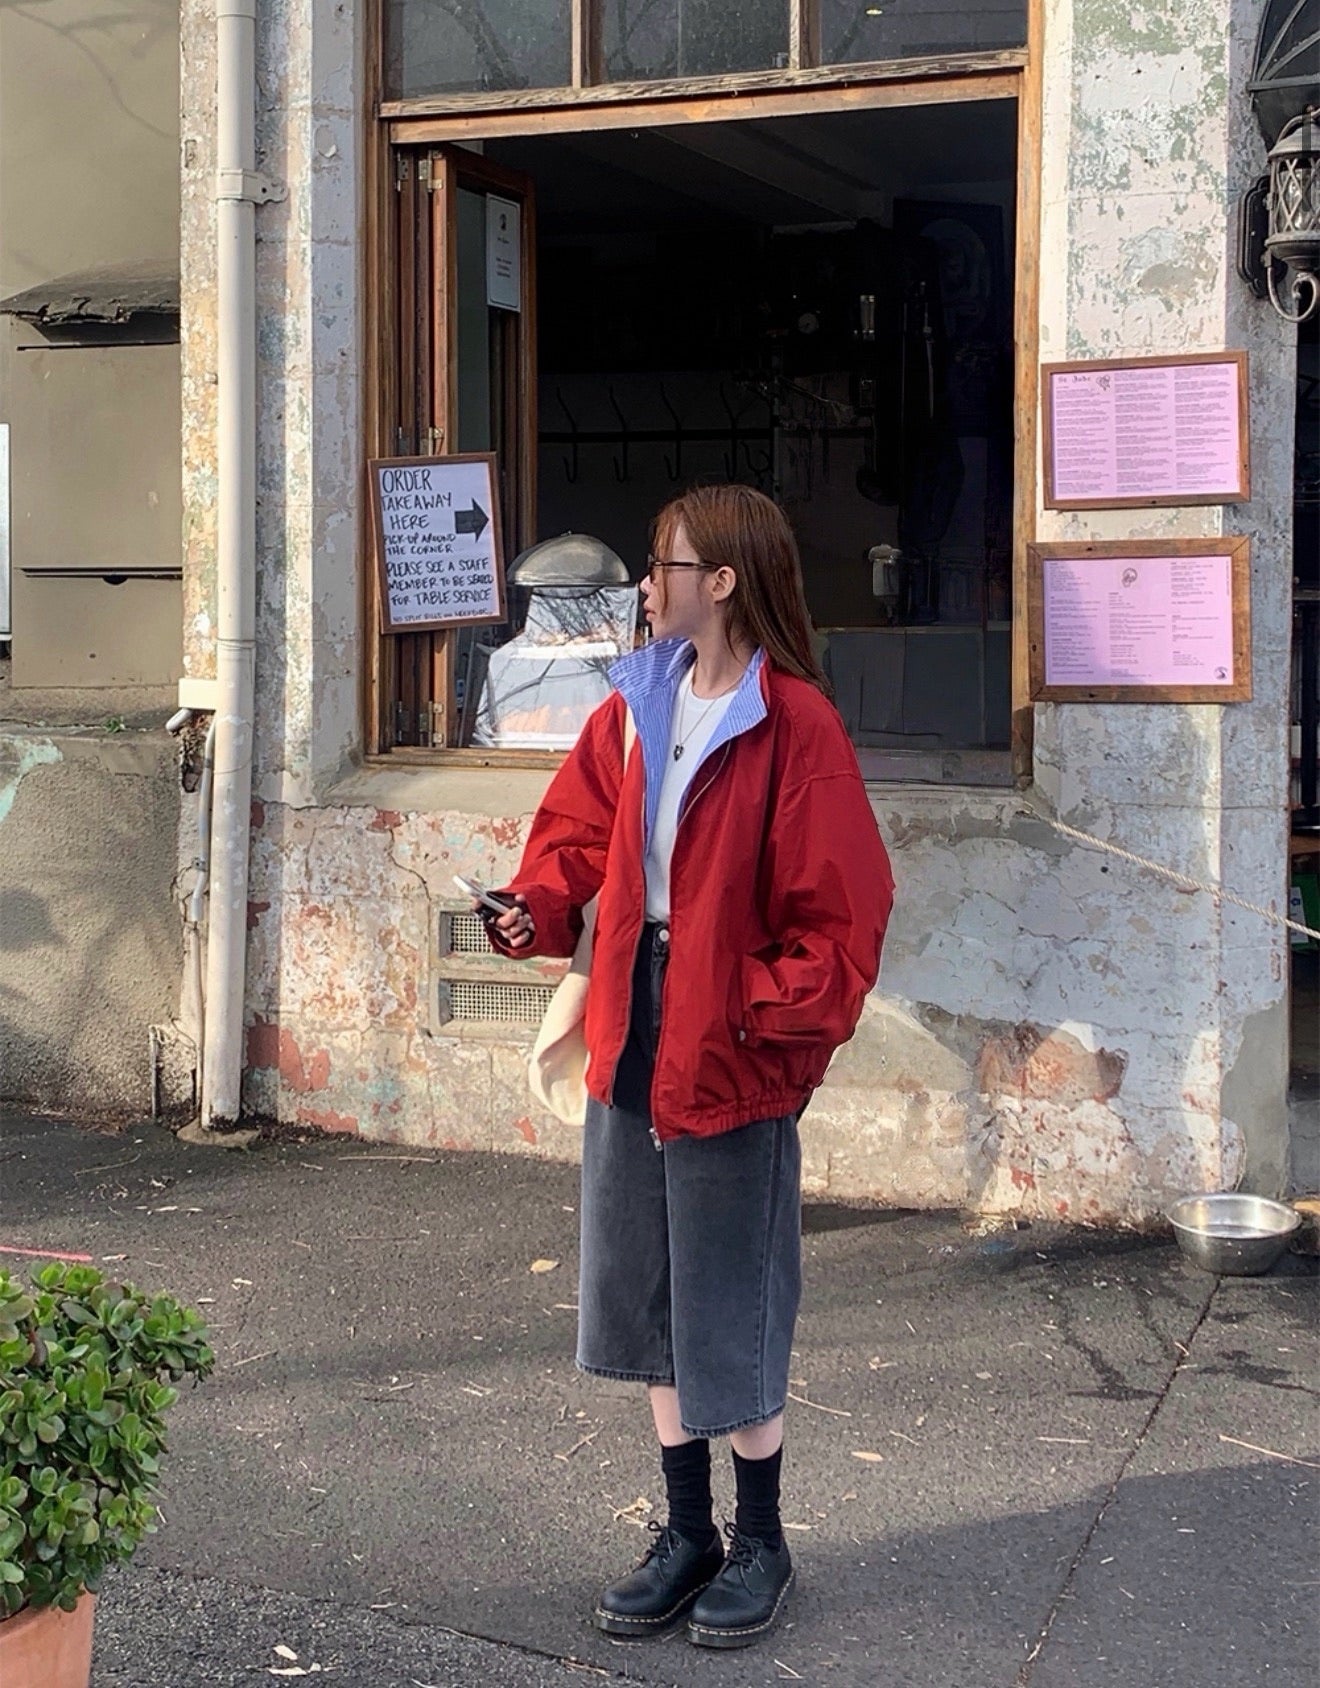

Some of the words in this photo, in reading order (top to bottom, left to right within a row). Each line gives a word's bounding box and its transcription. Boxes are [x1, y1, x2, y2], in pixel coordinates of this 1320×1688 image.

[382, 469, 432, 493] ORDER
[381, 492, 452, 512] TAKEAWAY
[390, 514, 430, 530] HERE
[421, 533, 457, 543] AROUND
[385, 545, 406, 555] THE
[410, 544, 454, 553] CORNER
[386, 560, 423, 577] PLEASE
[425, 560, 444, 574] SEE
[448, 561, 455, 572] A
[459, 557, 489, 571] STAFF
[388, 577, 437, 591] MEMBER
[452, 575, 465, 587] BE
[391, 594, 410, 606] FOR
[413, 590, 451, 605] TABLE
[453, 588, 492, 604] SERVICE
